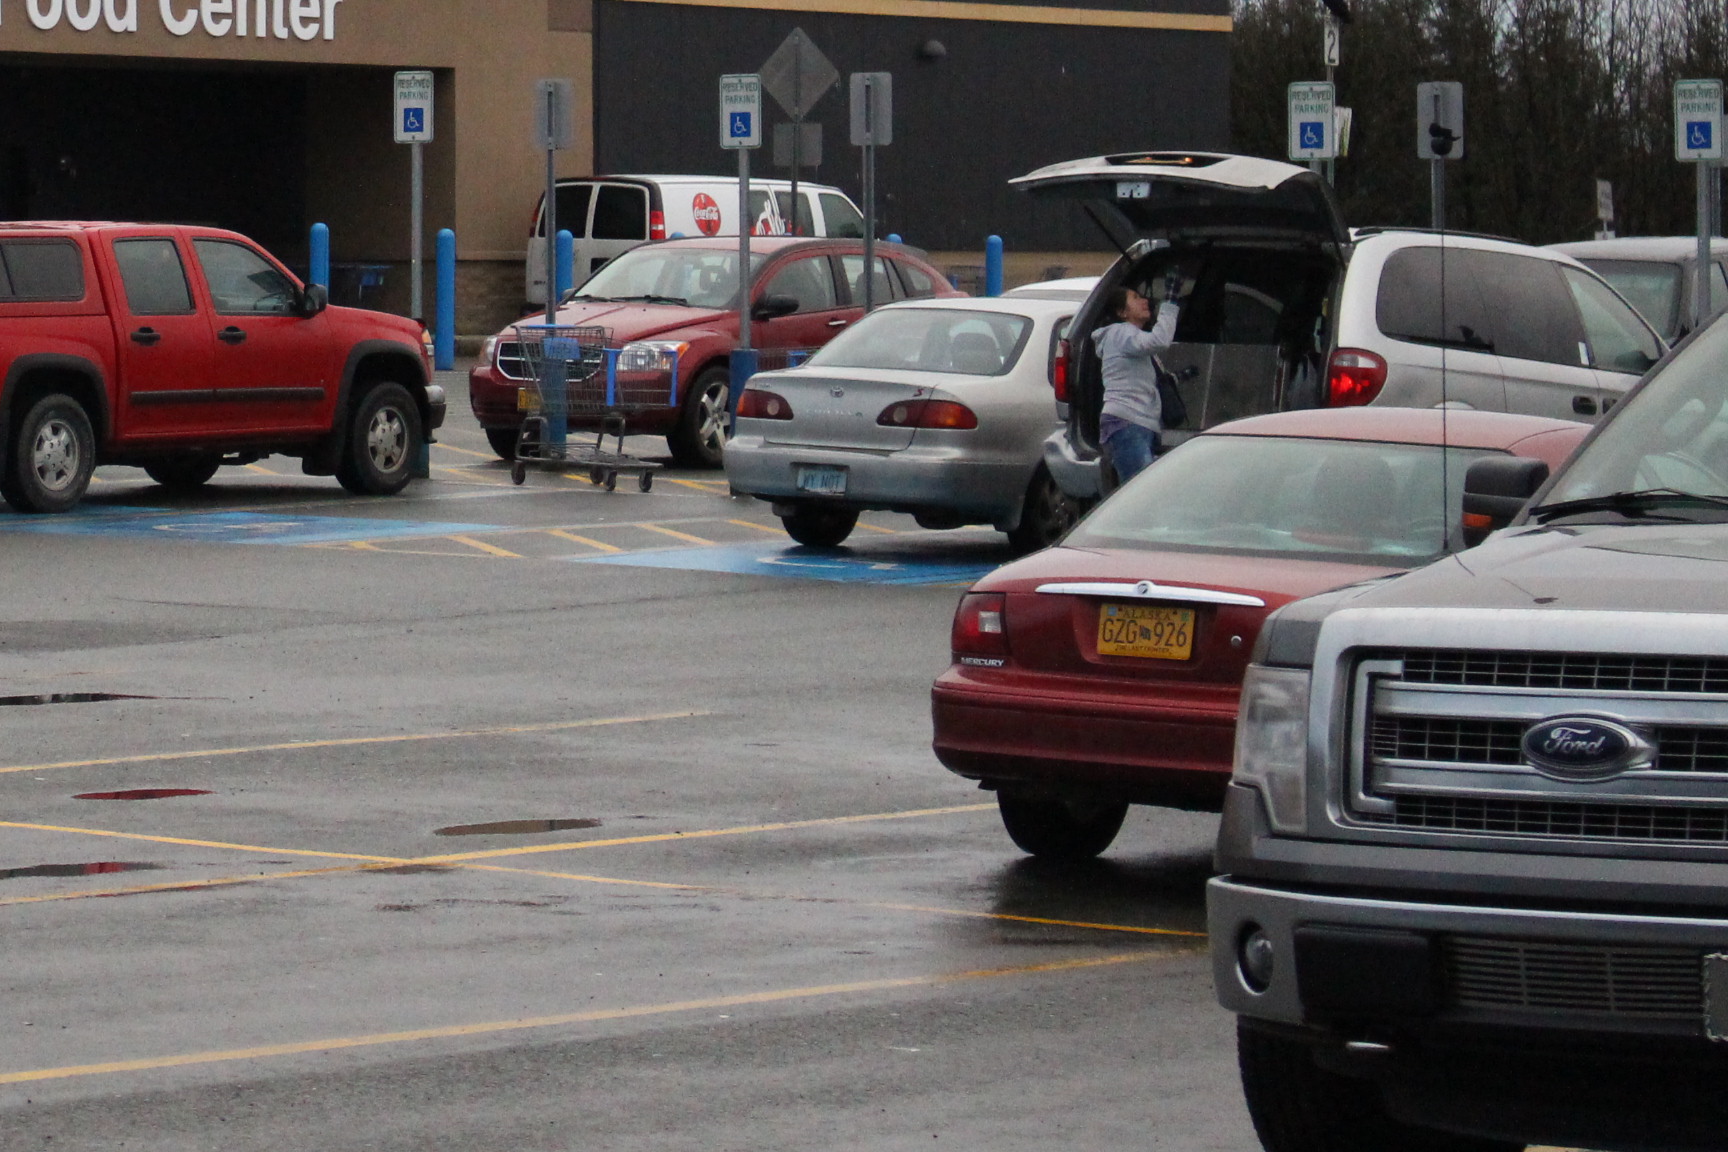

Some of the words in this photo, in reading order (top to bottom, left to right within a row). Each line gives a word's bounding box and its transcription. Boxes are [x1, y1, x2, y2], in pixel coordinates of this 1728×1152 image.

[1327, 30, 1336, 63] 2
[398, 79, 431, 89] RESERVED
[722, 82, 758, 92] RESERVED
[399, 91, 429, 101] PARKING
[1292, 90, 1332, 101] RESERVED
[1677, 88, 1720, 99] RESERVED
[725, 95, 756, 104] PARKING
[1294, 103, 1329, 114] PARKING
[1680, 102, 1717, 113] PARKING
[1122, 608, 1171, 620] ALASKA
[1102, 618, 1138, 644] GZG
[1154, 622, 1187, 647] 926
[961, 657, 1004, 666] MERCURY
[1543, 726, 1606, 754] Ford
